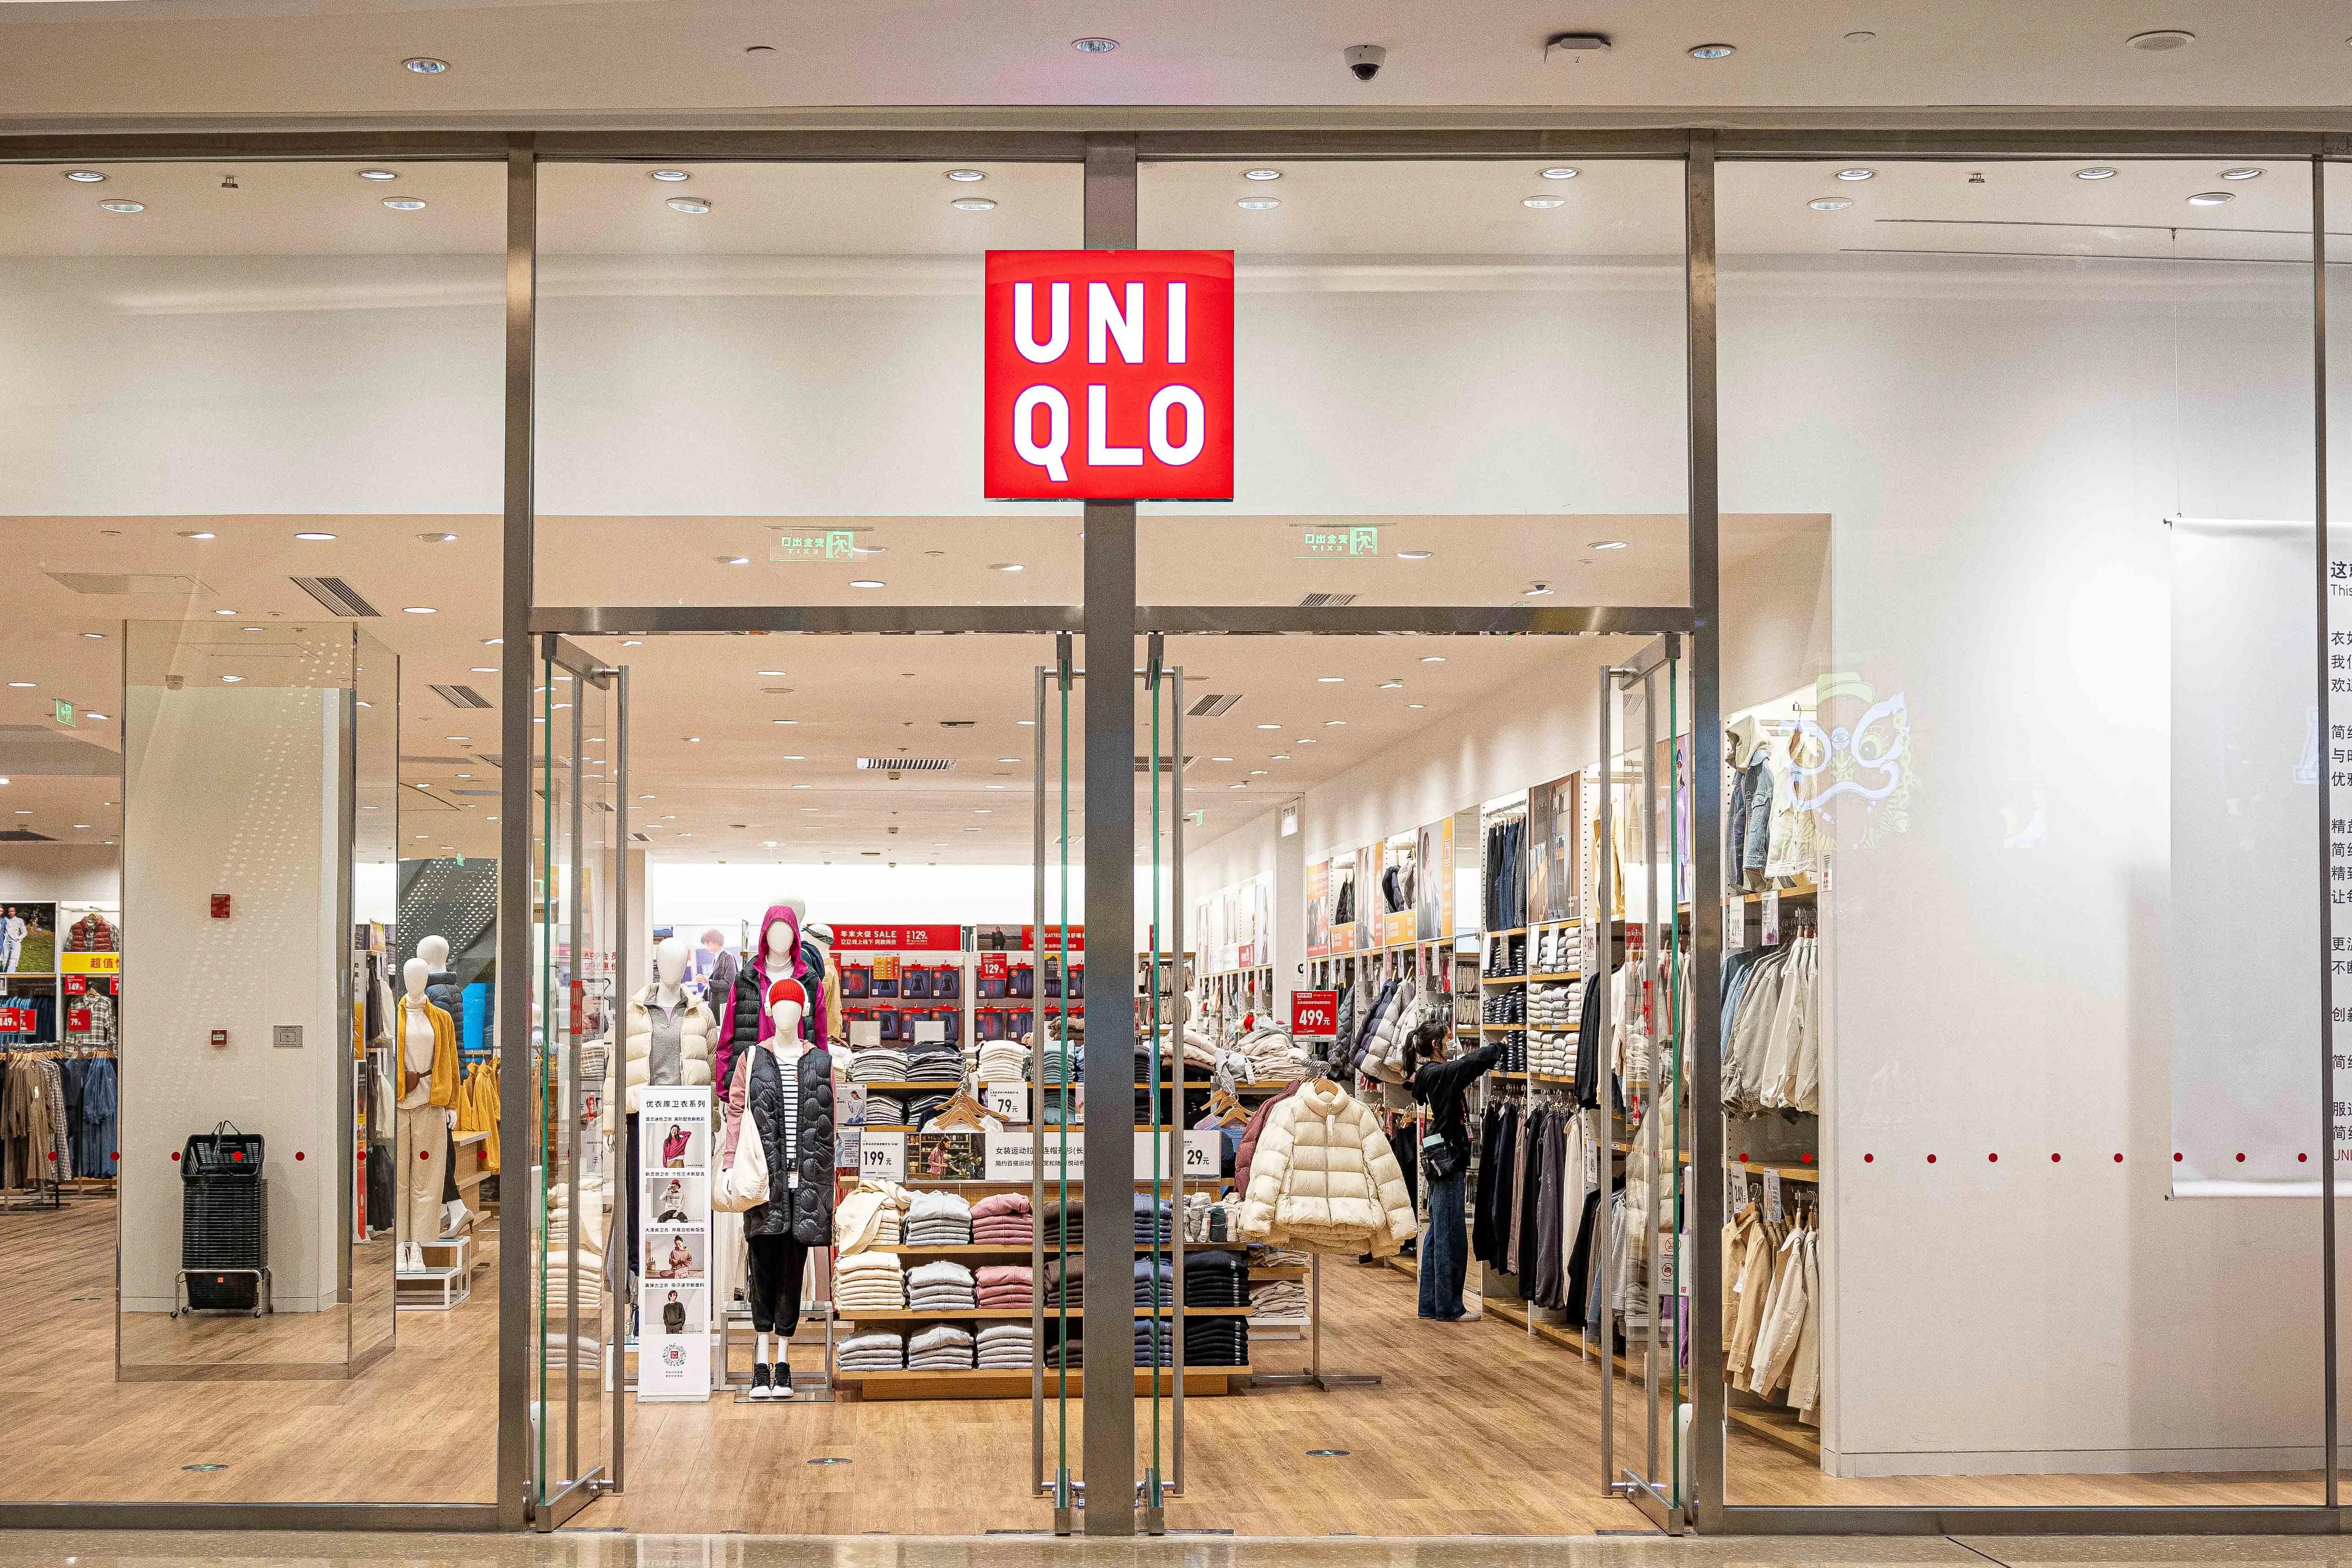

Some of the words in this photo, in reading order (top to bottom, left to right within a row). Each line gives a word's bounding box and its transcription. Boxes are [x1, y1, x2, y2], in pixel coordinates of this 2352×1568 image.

[1014, 281, 1187, 364] UNI
[1013, 383, 1206, 482] QLO
[2330, 561, 2352, 578] 这
[90, 958, 119, 968] 超值
[984, 963, 1004, 974] 129元
[1299, 1010, 1330, 1025] 499元
[998, 1099, 1018, 1112] 79元
[864, 1152, 892, 1165] 199元
